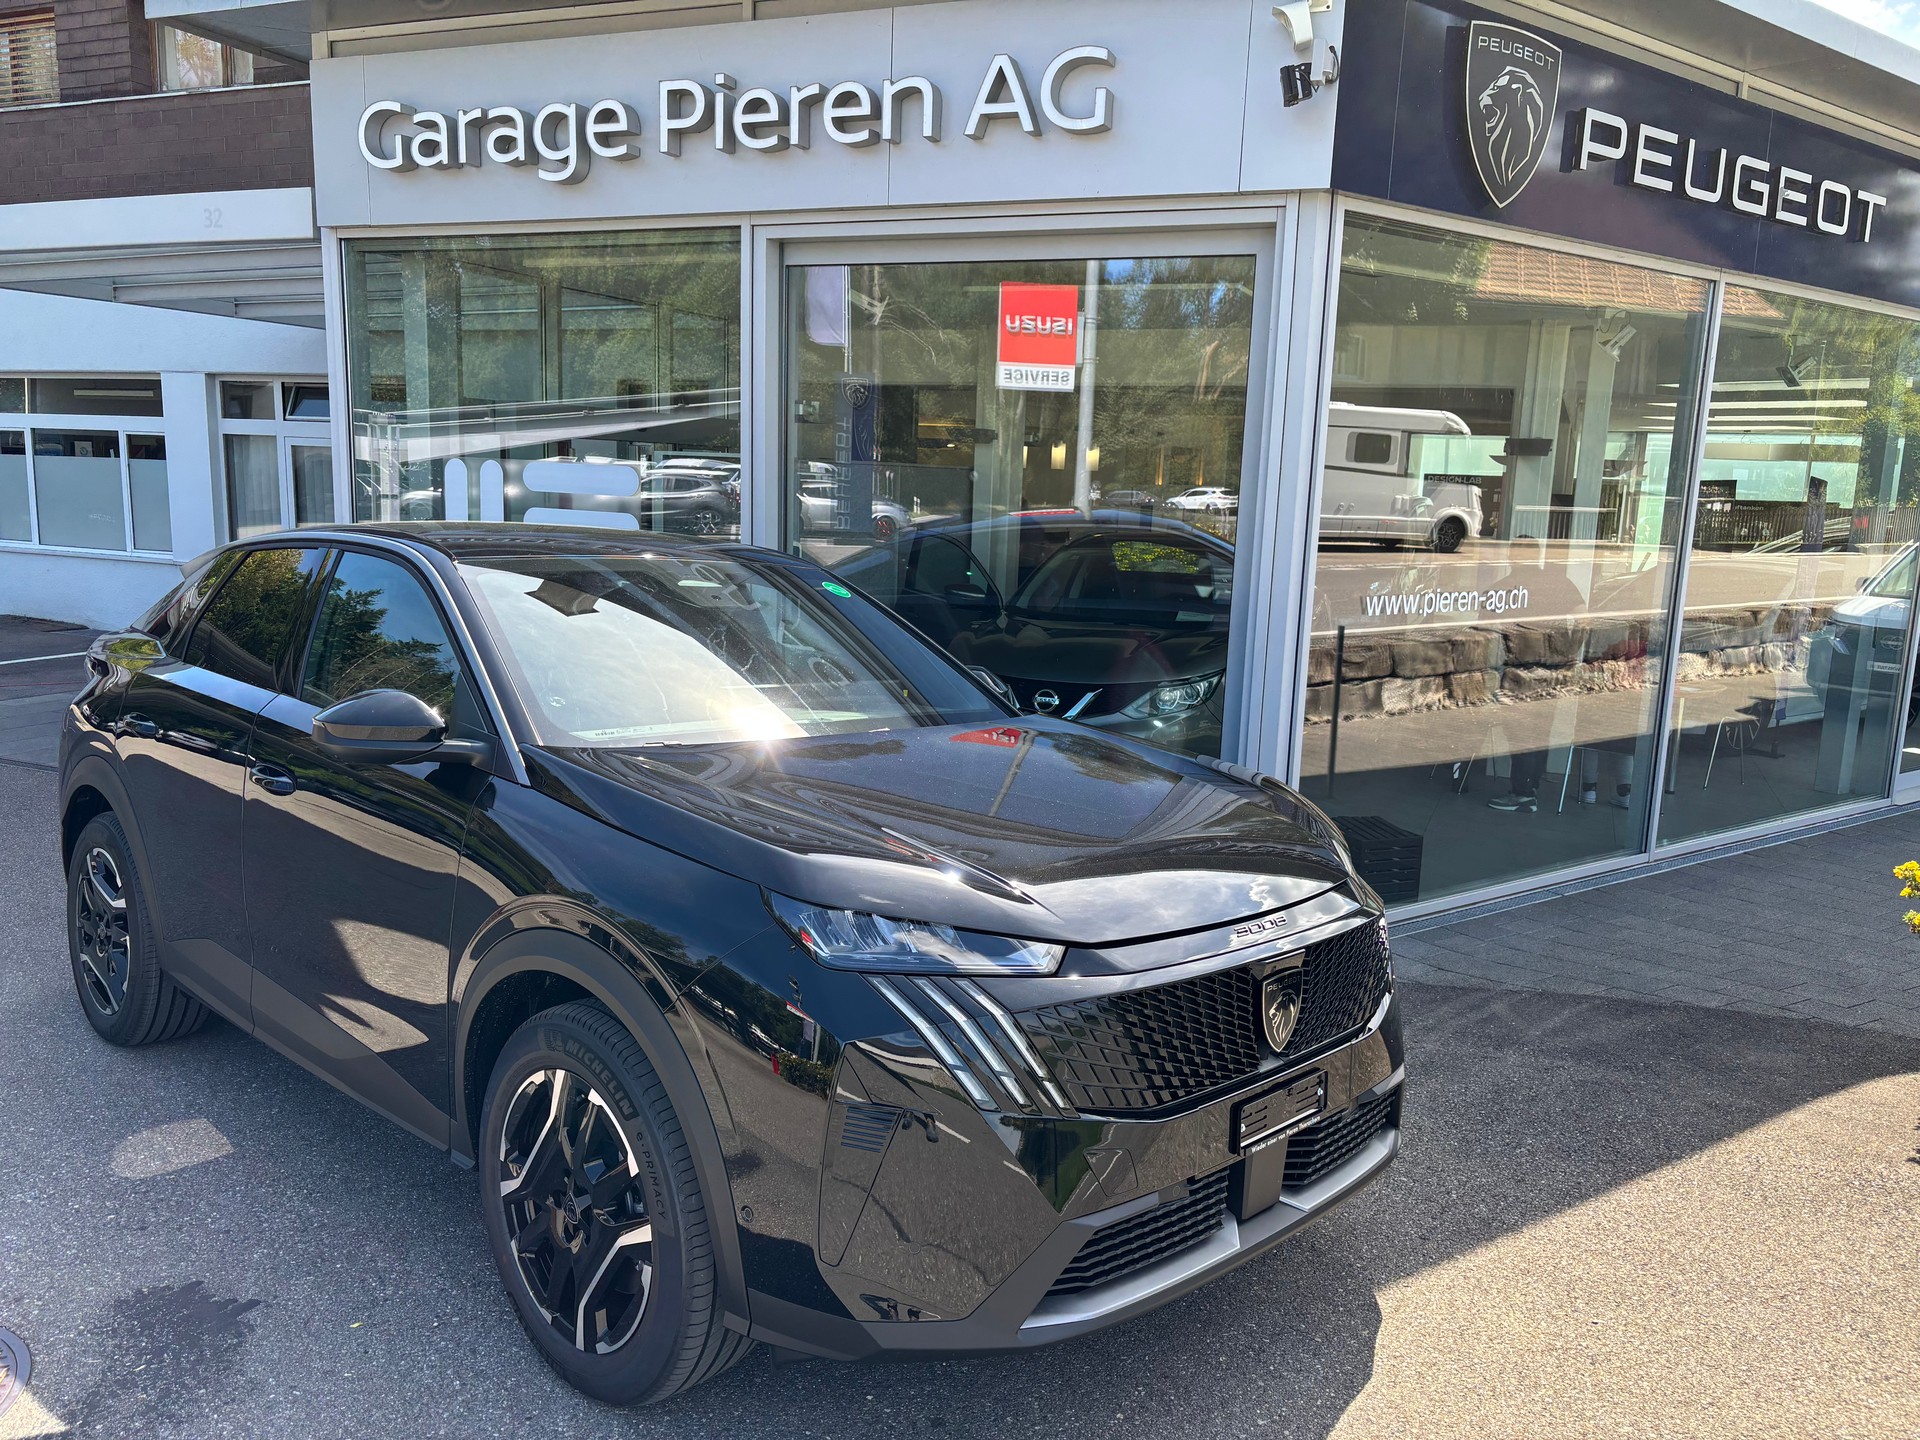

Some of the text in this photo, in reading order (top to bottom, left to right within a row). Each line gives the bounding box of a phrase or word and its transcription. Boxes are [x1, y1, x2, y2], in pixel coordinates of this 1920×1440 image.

[1478, 35, 1555, 71] PEUGEOT
[358, 44, 1115, 186] Garage Pieren AG
[1578, 106, 1888, 244] PEUGEOT
[203, 207, 224, 229] 32
[1366, 585, 1529, 617] www.pieren-ag.ch
[1233, 915, 1288, 938] 3008
[1267, 975, 1301, 992] PEUGEOT
[566, 1039, 634, 1118] MICHELIN
